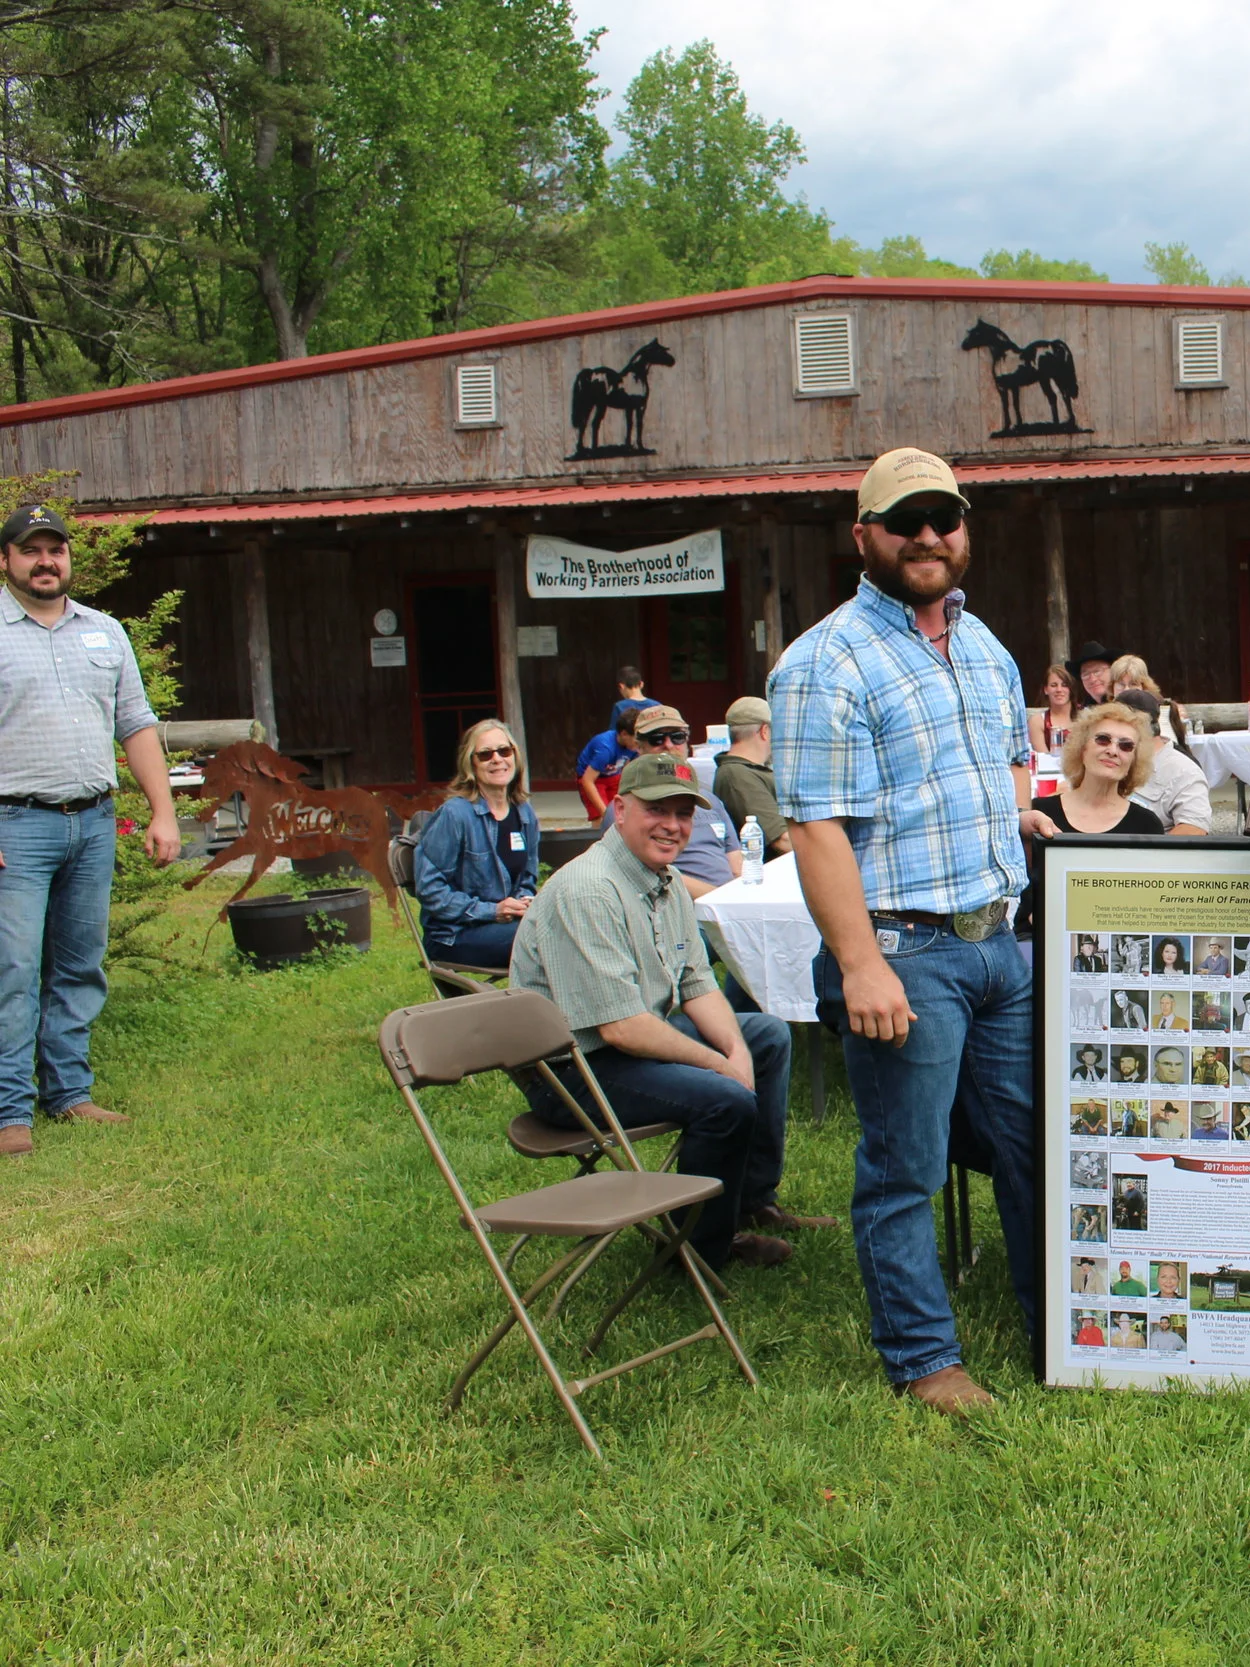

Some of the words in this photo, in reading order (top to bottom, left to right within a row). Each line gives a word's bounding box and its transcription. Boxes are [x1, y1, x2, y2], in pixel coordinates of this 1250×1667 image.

[560, 556, 585, 574] The
[587, 553, 672, 575] Brotherhood
[676, 551, 690, 568] of
[535, 572, 587, 590] Working
[591, 574, 640, 588] Farriers
[643, 566, 715, 585] Association
[1071, 879, 1090, 888] THE
[1092, 879, 1165, 889] BROTHERHOOD
[1167, 880, 1180, 889] OF
[1183, 881, 1228, 890] WORKING
[1160, 895, 1194, 903] Farriers
[1196, 896, 1215, 904] Hall
[1216, 896, 1228, 904] Of
[1203, 1163, 1220, 1171] 2017
[1192, 1312, 1215, 1321] BWFA
